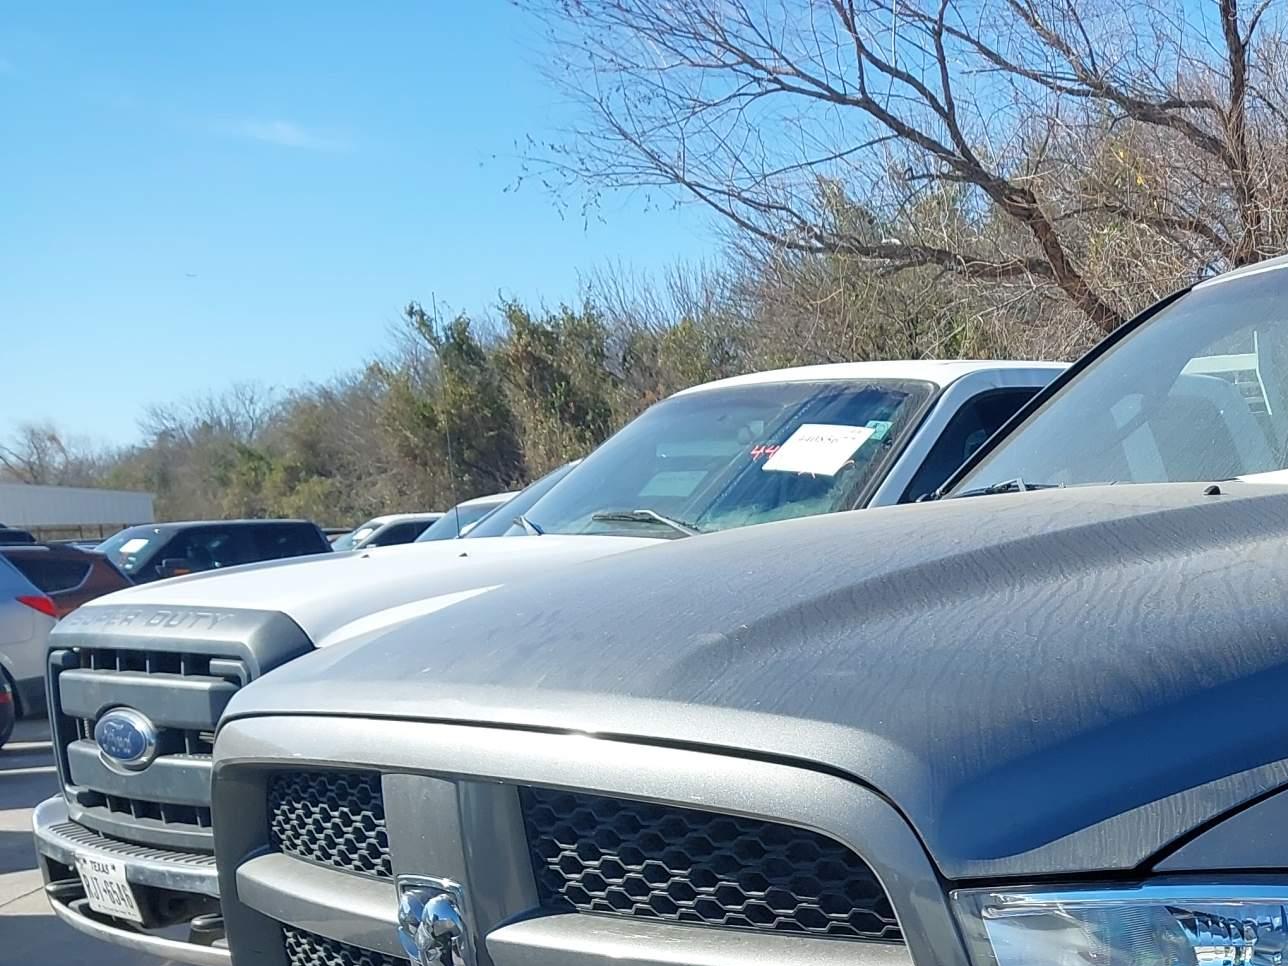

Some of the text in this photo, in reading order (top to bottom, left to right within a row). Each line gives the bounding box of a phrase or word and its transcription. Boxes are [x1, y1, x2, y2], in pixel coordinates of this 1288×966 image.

[69, 609, 235, 629] SUPER DUTY
[89, 860, 110, 875] TEXAS
